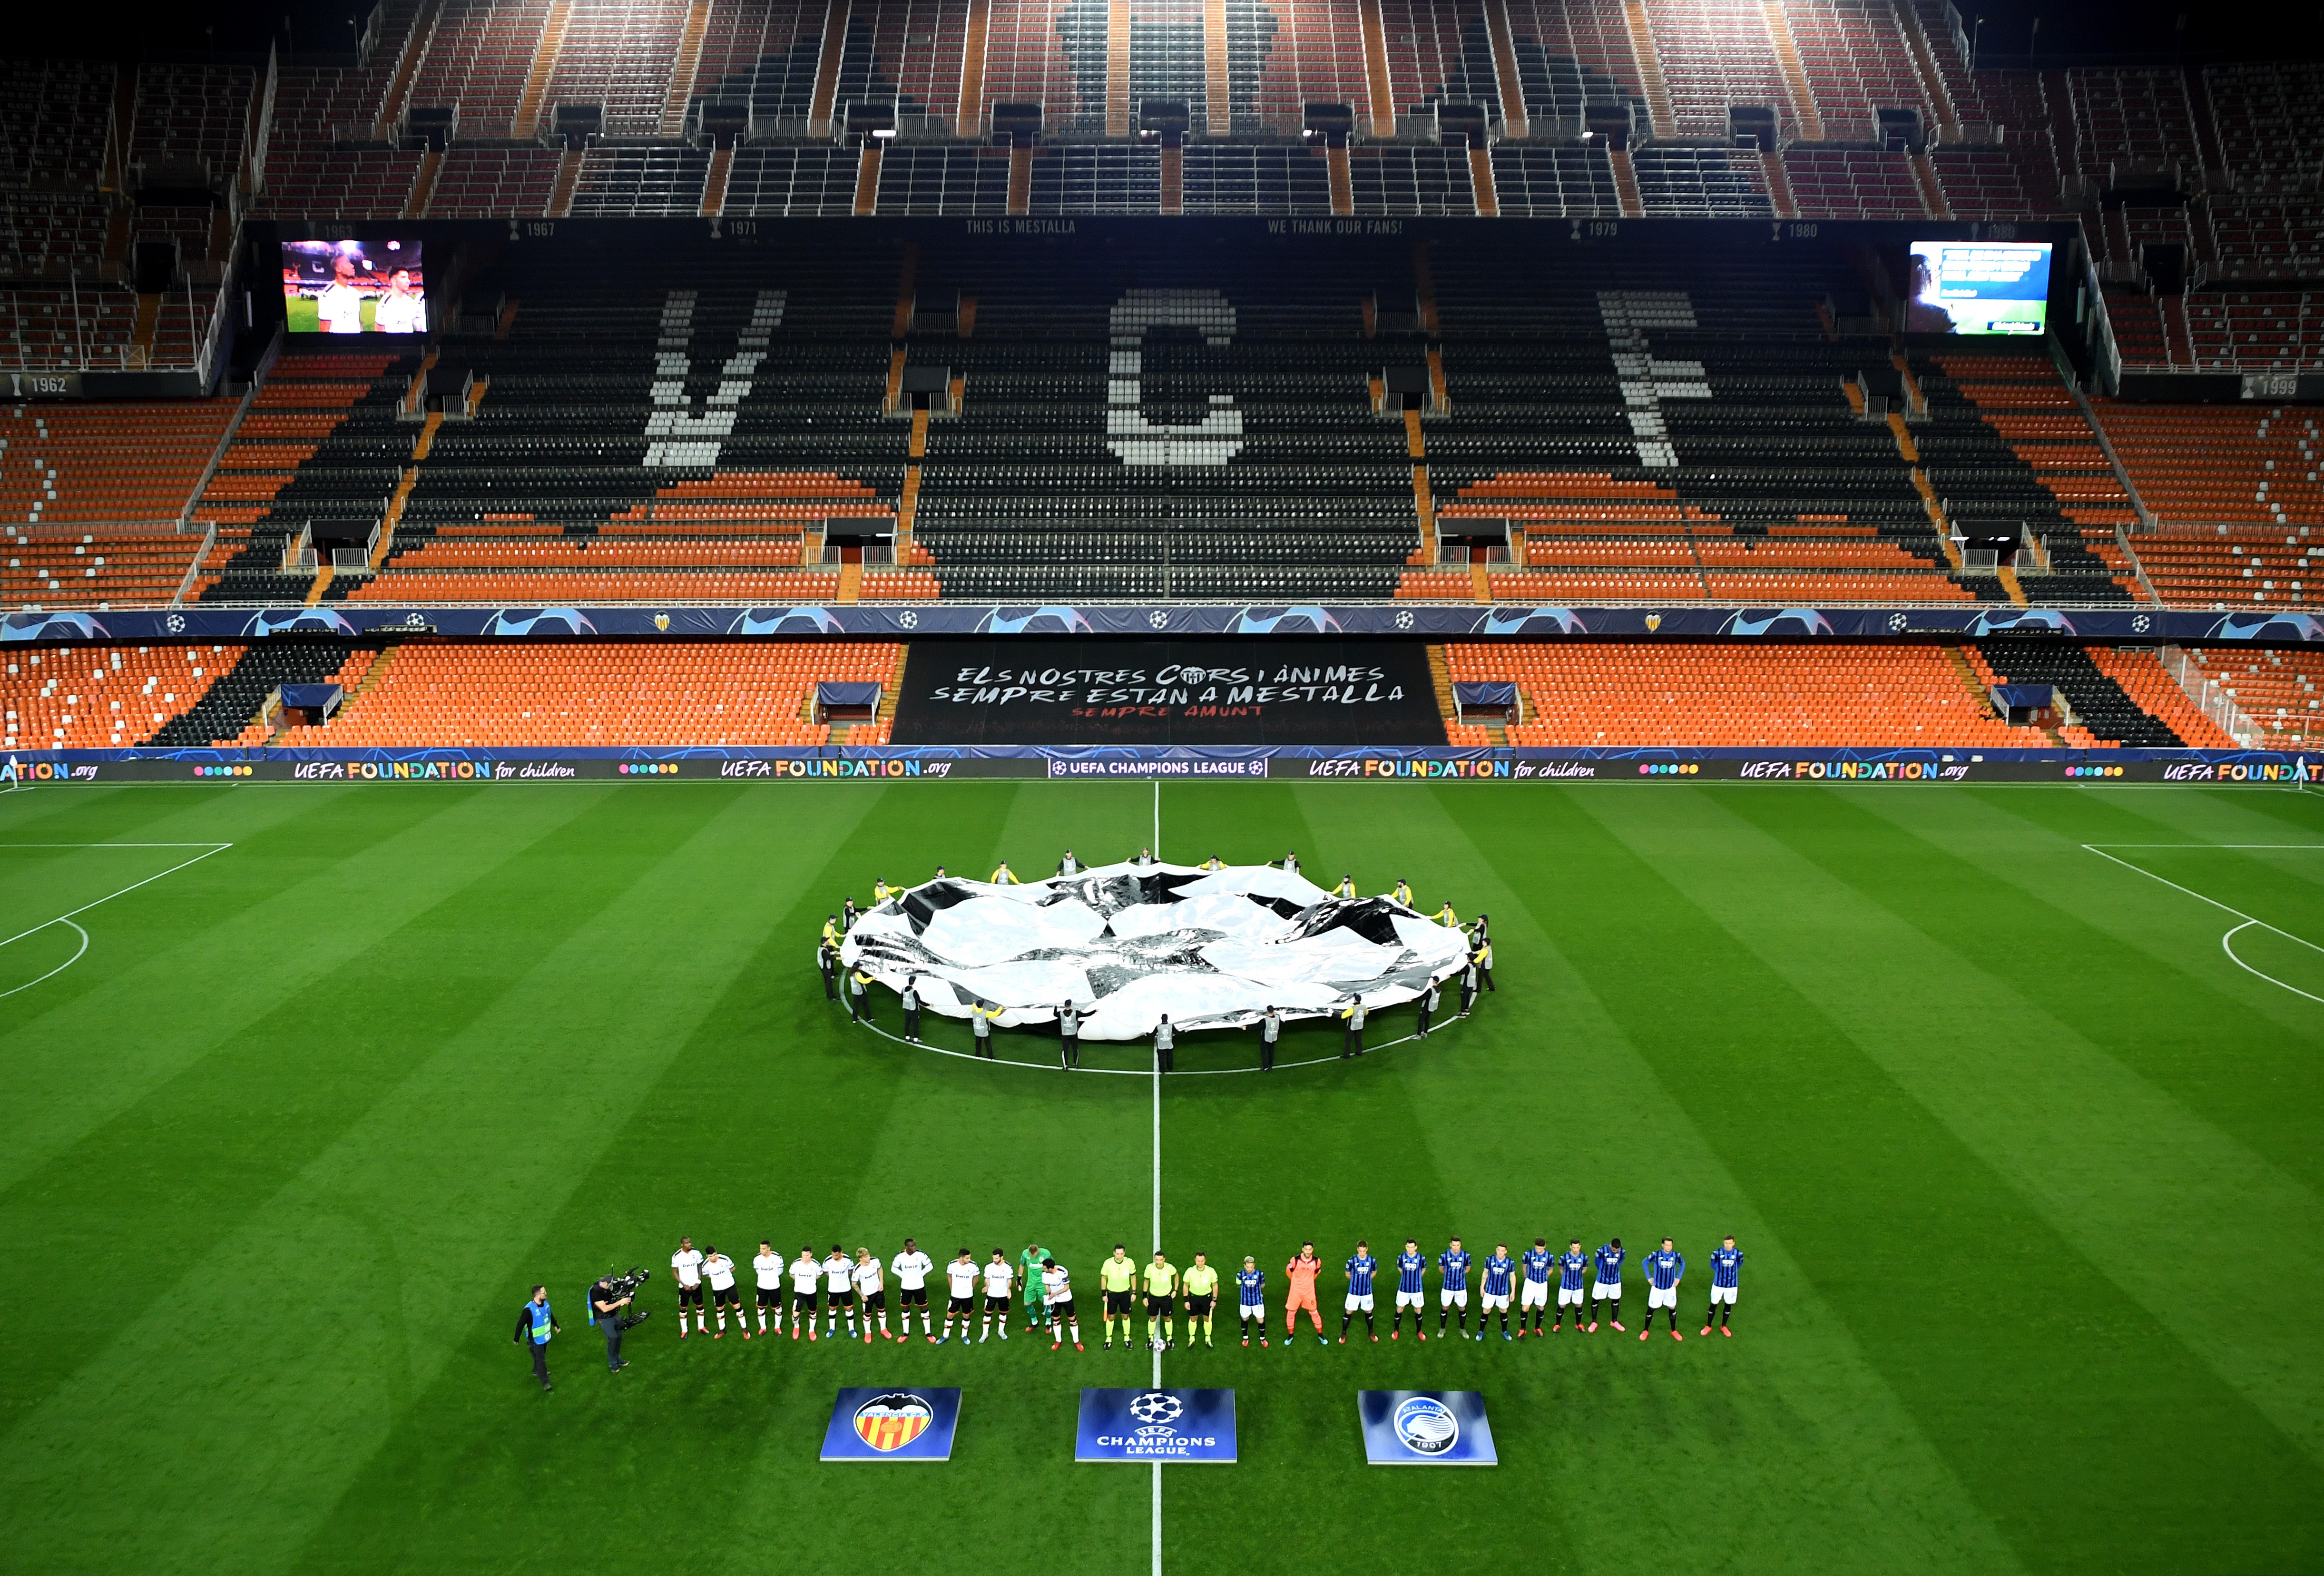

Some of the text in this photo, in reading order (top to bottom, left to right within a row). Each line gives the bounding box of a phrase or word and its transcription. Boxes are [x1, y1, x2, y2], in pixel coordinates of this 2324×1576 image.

[527, 222, 554, 236] 1967
[730, 221, 756, 235] 1971
[966, 219, 1076, 233] THIS IS MESTALLA
[1268, 220, 1402, 234] WE THANK OUR FANS!
[1588, 222, 1618, 236] 1979
[1789, 223, 1817, 237] 1980
[32, 377, 66, 392] 1962
[2264, 380, 2297, 394] 1999
[957, 666, 1012, 684] ELS
[1019, 668, 1147, 686] NOSTRES
[1257, 670, 1265, 682] I
[929, 683, 1404, 705] SEMPRE ESTAN A MESTALLA
[1071, 705, 1265, 718] SEMPRE AMUNT
[294, 761, 575, 780] UEFA FOUNDATION for children
[721, 760, 772, 777] UEFA
[775, 760, 921, 777] FOUNDATION
[1070, 762, 1245, 774] UEFA CHAMPIONS LEAGUE
[1309, 760, 1595, 779] UEFA FOUNDATION for children
[1740, 762, 1792, 778] UEFA
[1795, 762, 1938, 778] FOUNDATION
[2164, 764, 2324, 781] UEFA FOUNDAT
[1402, 1405, 1443, 1413] ATALANTA
[1137, 1428, 1173, 1437] UEFA
[1097, 1436, 1216, 1446] CHAMPIONS
